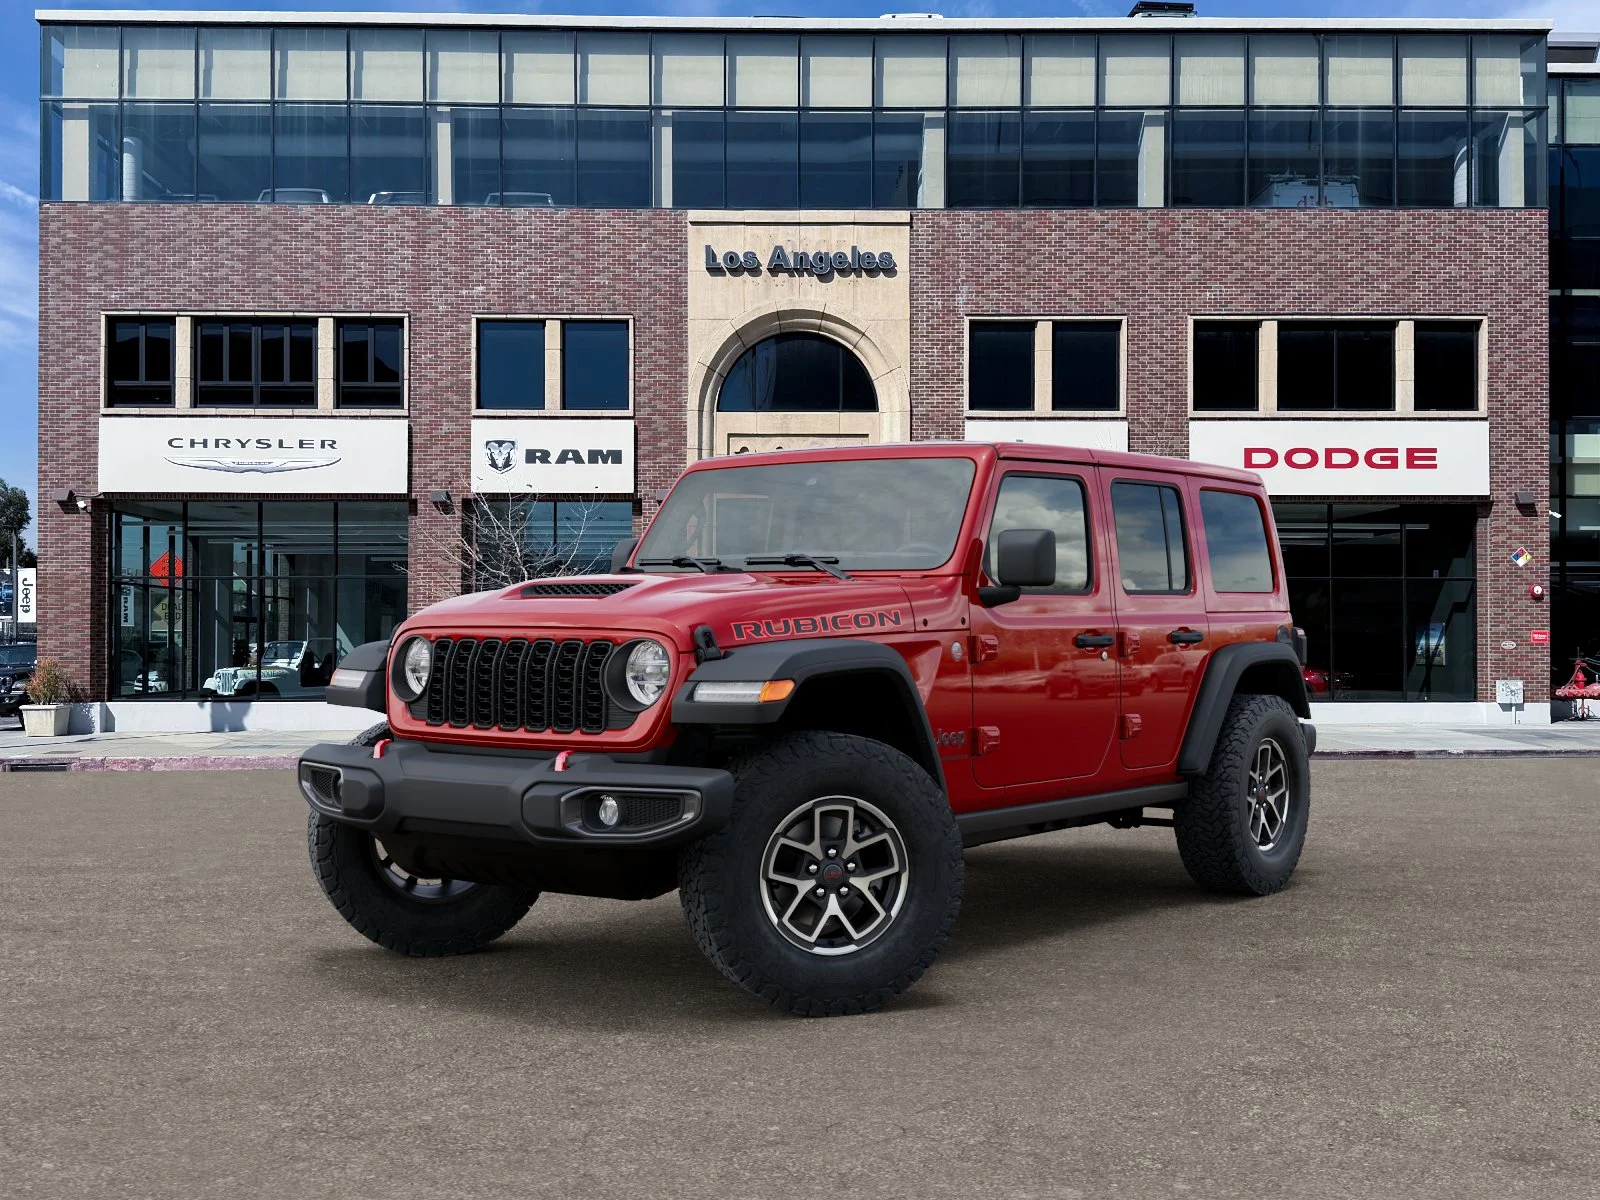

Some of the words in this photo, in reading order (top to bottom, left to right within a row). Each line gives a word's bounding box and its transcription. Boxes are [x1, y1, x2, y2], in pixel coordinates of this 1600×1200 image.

[705, 244, 758, 269] Los
[767, 244, 894, 275] Angeles
[168, 438, 337, 449] CHRYSLER
[525, 448, 623, 464] RAM
[1244, 447, 1438, 468] DODGE
[20, 578, 33, 613] Jeep
[731, 610, 902, 640] RUBICON
[936, 728, 966, 748] Jeep
